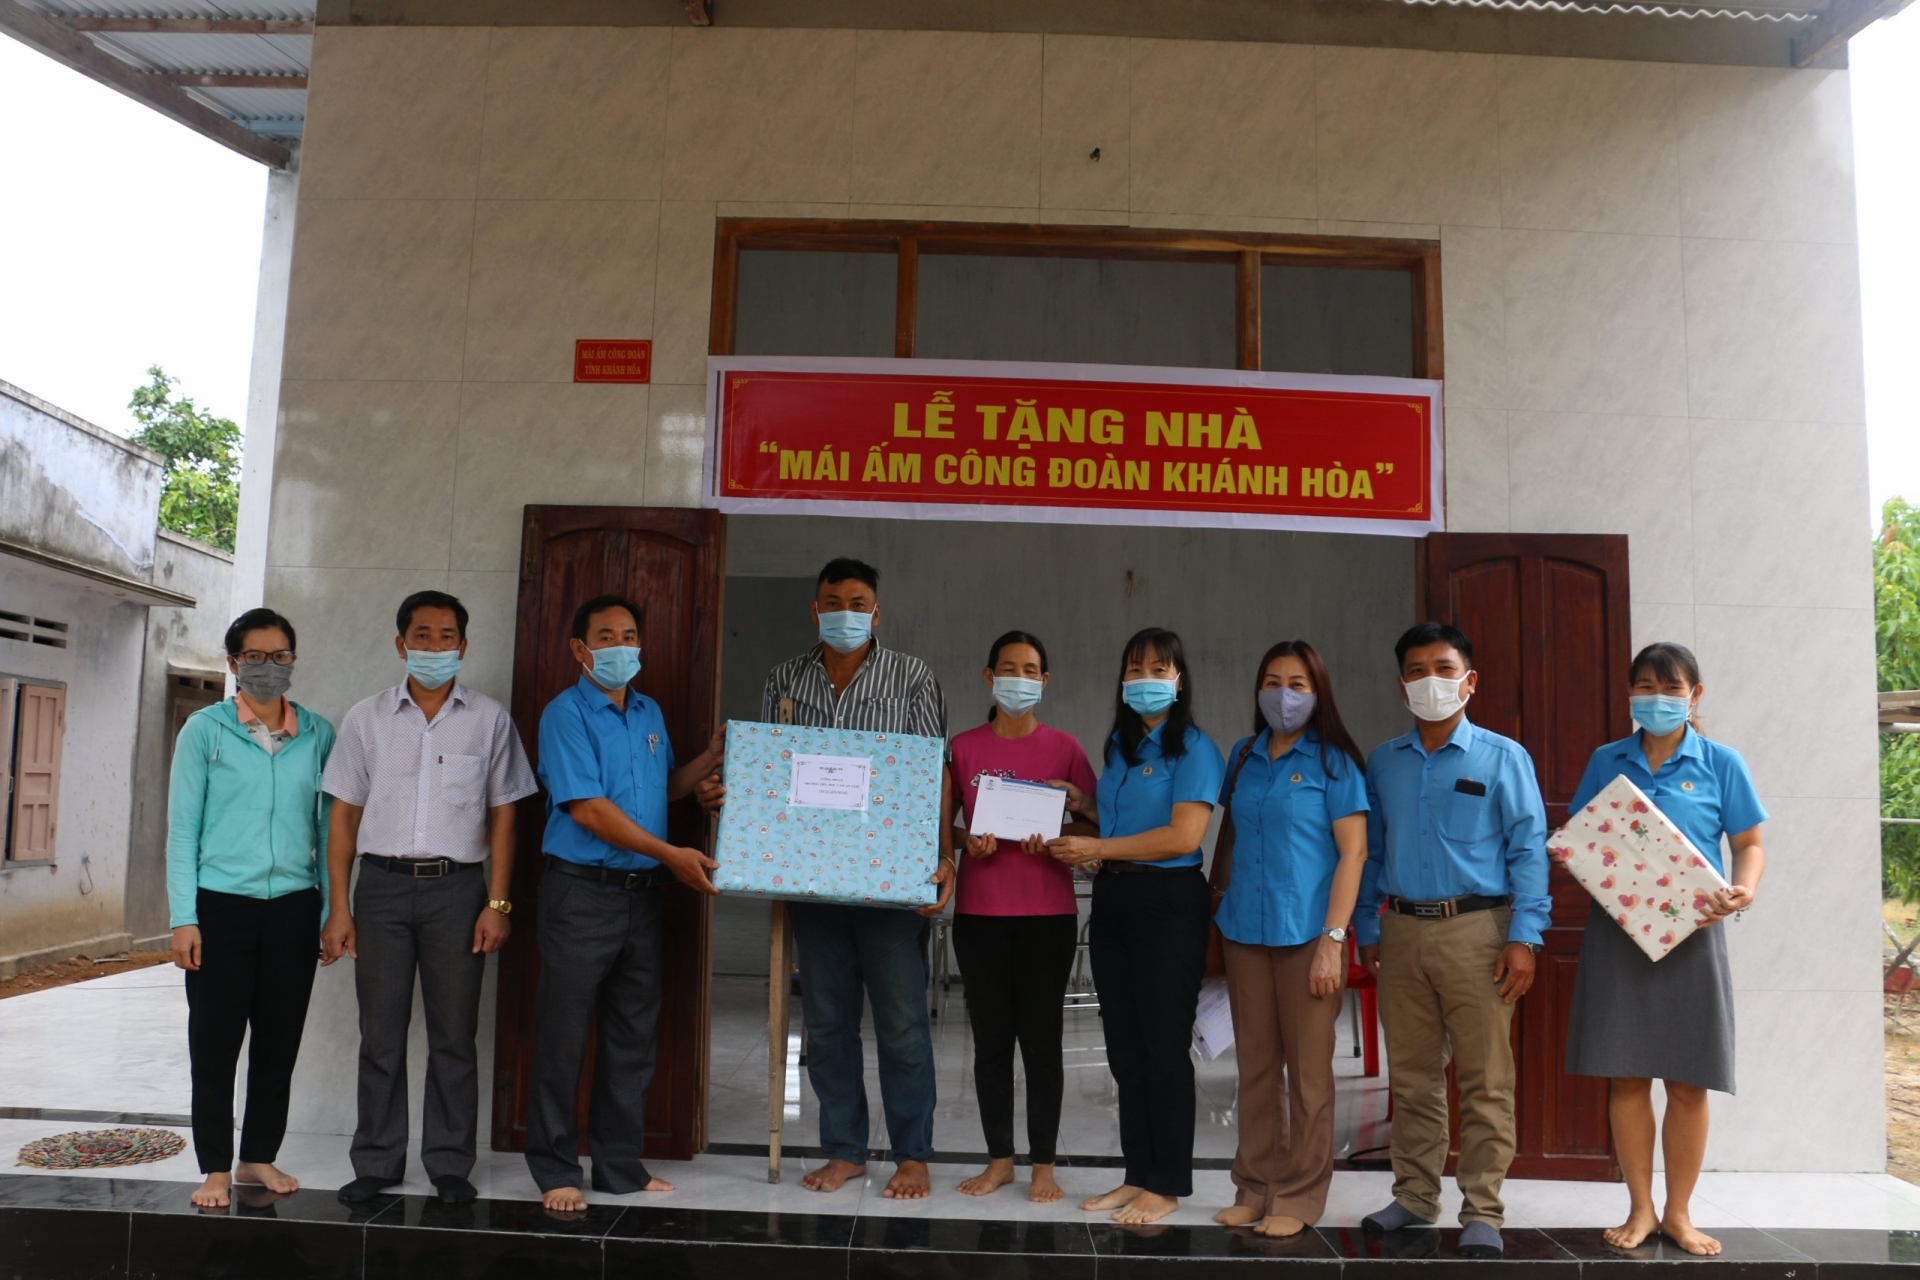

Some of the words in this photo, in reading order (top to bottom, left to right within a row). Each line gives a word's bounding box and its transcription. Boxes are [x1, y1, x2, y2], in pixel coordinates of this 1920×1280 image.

[581, 347, 595, 359] MÁI
[596, 345, 607, 359] ẤM
[608, 347, 626, 359] CÔNG
[627, 347, 646, 359] ĐOÀN
[602, 362, 626, 375] KHÁNH
[627, 362, 641, 375] HÒA
[893, 390, 956, 440] LỄ
[975, 398, 1125, 450] TẶNG
[1145, 407, 1263, 450] NHÀ
[759, 440, 851, 482] “MÁI
[861, 441, 922, 484] ẤM
[934, 447, 1036, 488] CÔNG
[1047, 452, 1151, 492] ĐOÀN
[1162, 457, 1289, 497] KHÁNH
[1300, 461, 1395, 500] HÒA”
